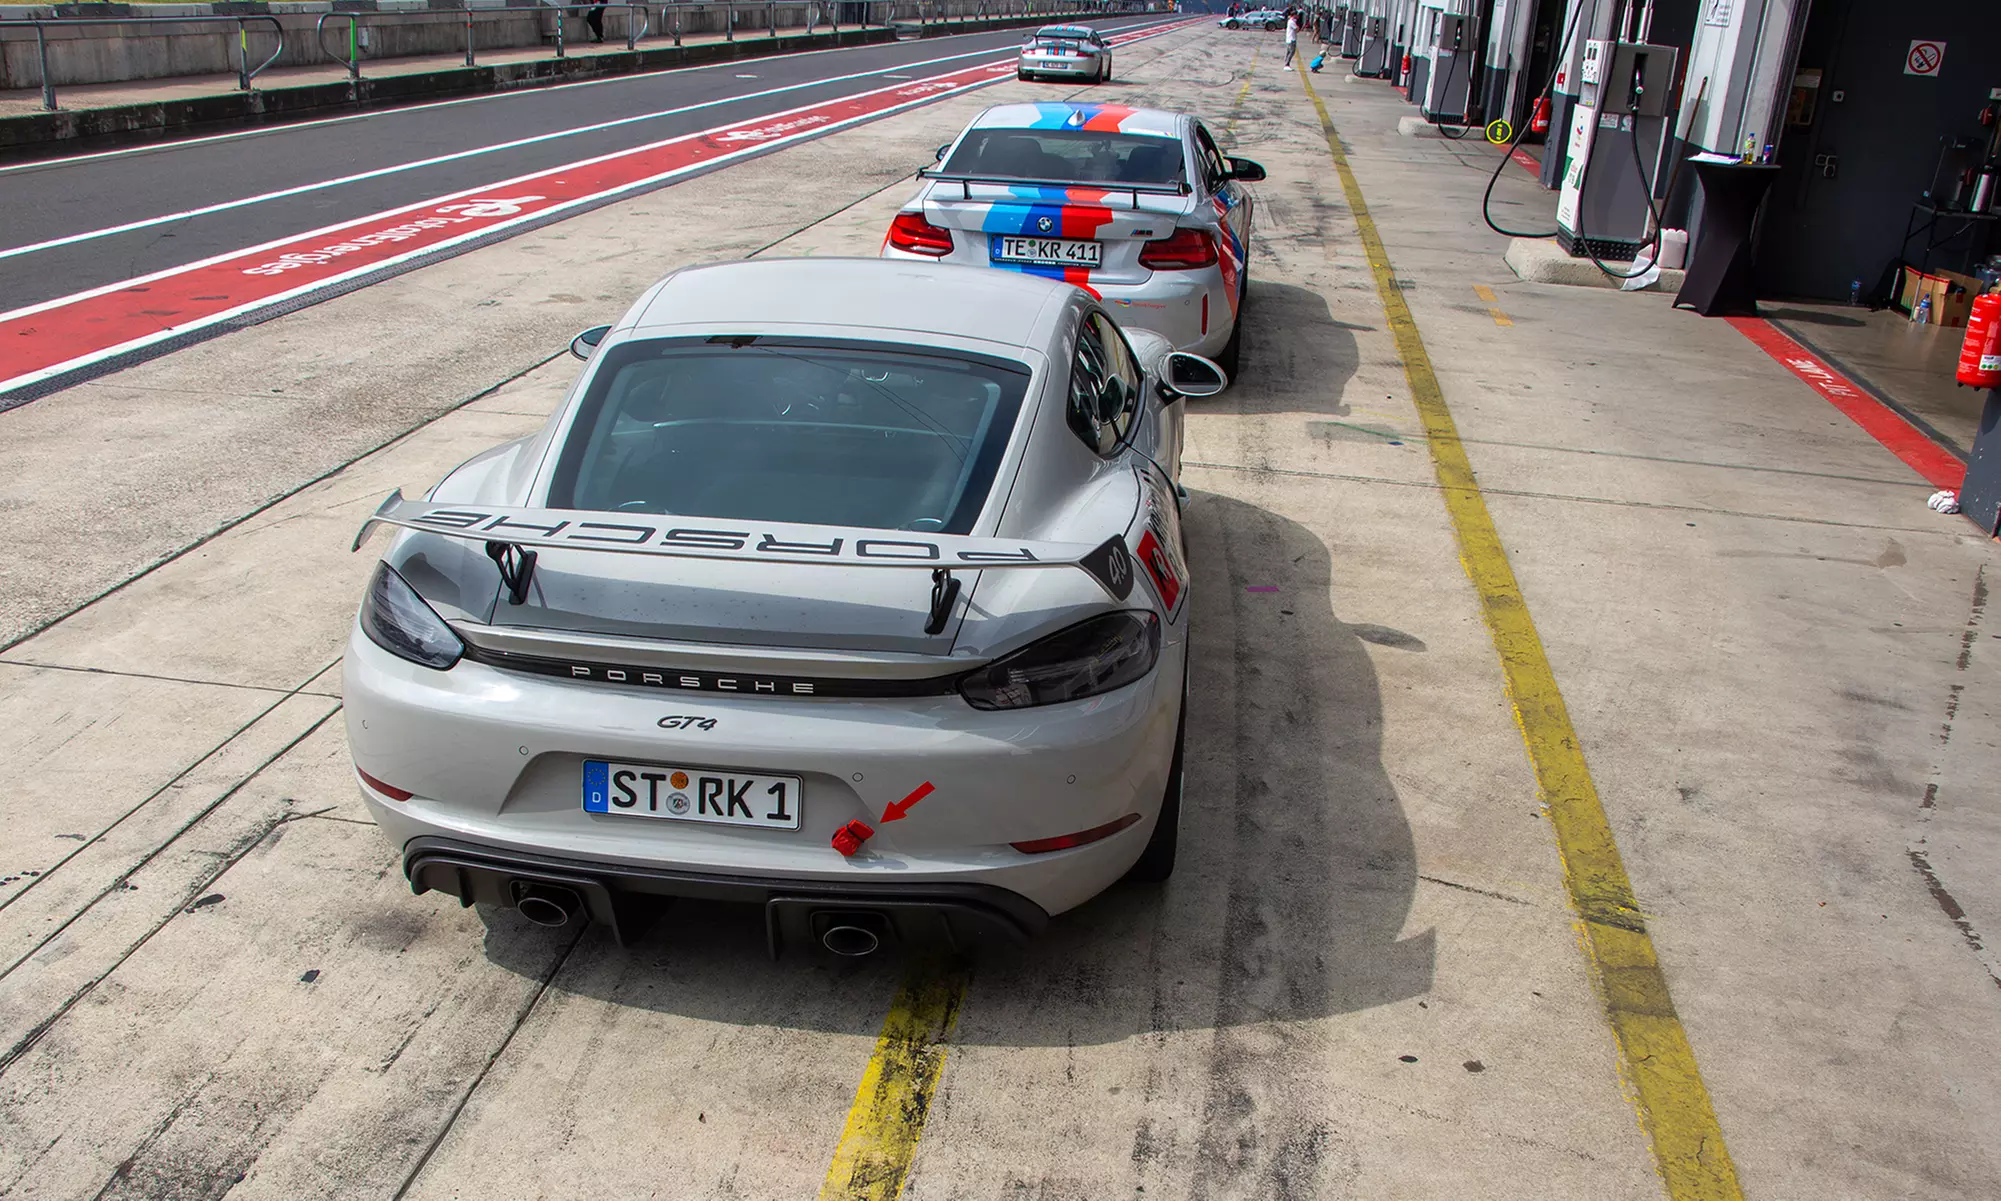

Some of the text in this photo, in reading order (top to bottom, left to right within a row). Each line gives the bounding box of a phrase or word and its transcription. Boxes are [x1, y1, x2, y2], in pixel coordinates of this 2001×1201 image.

[242, 216, 473, 276] TotalEnergies
[1004, 239, 1099, 261] TE KR 411
[410, 510, 1040, 562] PORSCHE
[1108, 545, 1128, 586] 4.0
[571, 665, 815, 694] PORSCHE
[656, 715, 718, 731] GT4
[591, 791, 602, 804] D
[611, 769, 792, 821] ST RK 1
